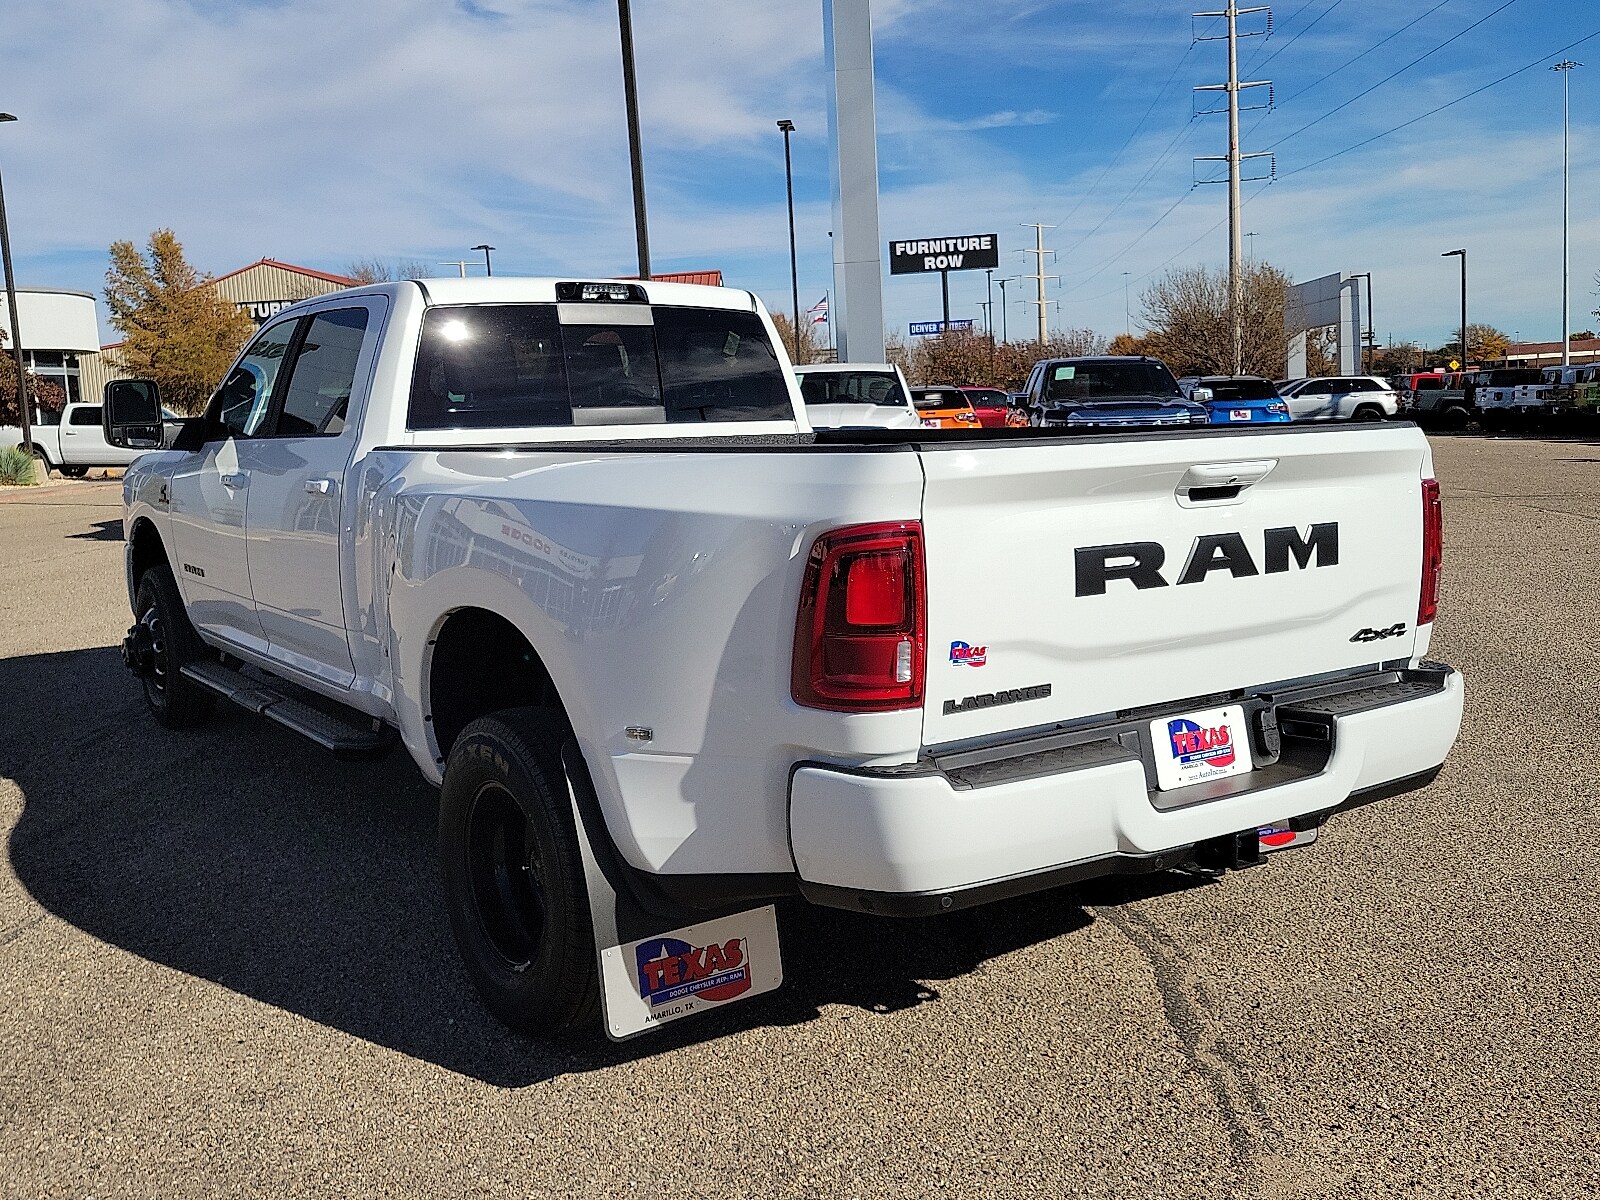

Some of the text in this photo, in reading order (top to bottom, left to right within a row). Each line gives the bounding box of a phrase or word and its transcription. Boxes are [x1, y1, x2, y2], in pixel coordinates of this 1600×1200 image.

[895, 236, 992, 256] FURNITURE
[923, 254, 964, 270] ROW
[911, 323, 937, 333] DENVER
[1073, 521, 1339, 597] RAM
[952, 646, 987, 659] TEXAS
[943, 683, 1052, 716] LARAMIE
[1173, 725, 1230, 755] TEXAS
[643, 938, 744, 991] TEXAS
[669, 987, 688, 998] DODGE
[689, 979, 715, 993] CHRYSLER
[729, 972, 743, 982] RAM
[644, 1002, 695, 1024] AMARILLO, TX
